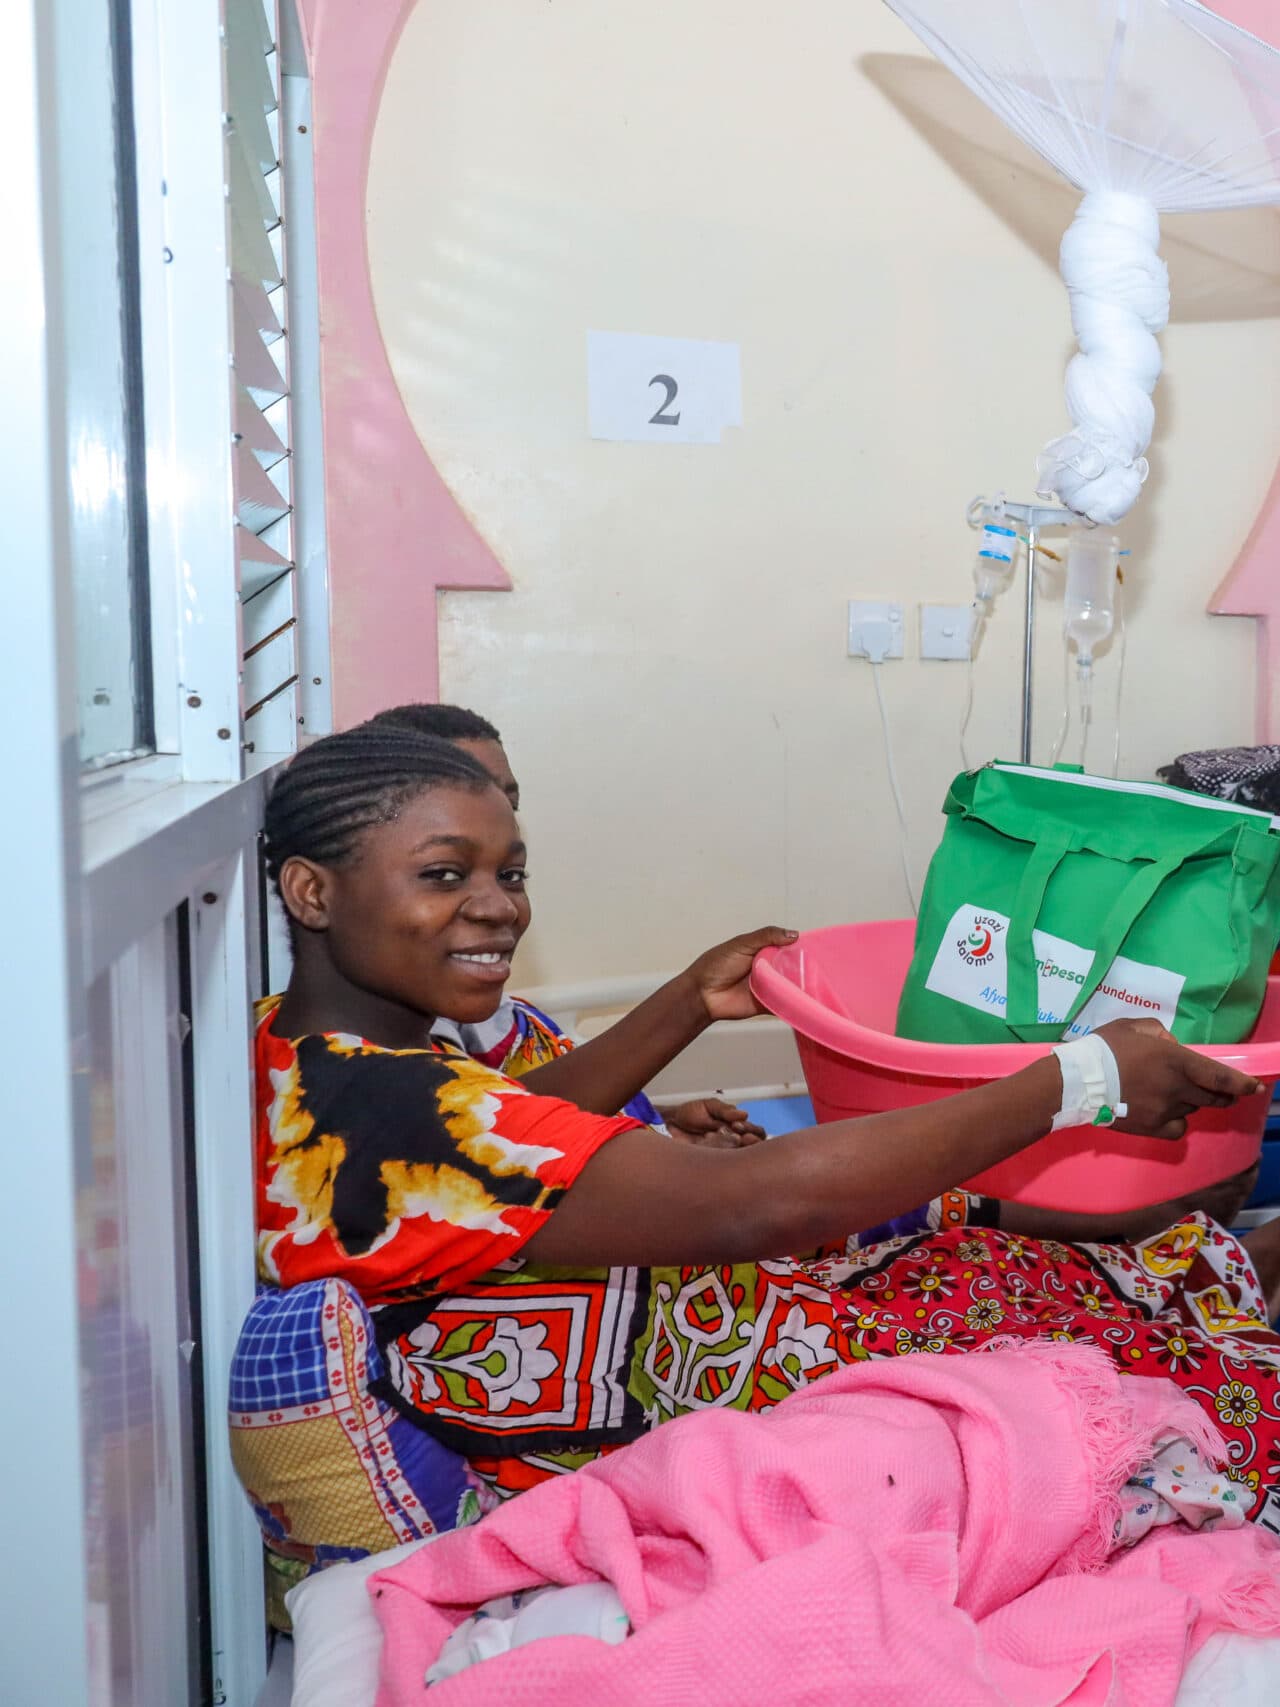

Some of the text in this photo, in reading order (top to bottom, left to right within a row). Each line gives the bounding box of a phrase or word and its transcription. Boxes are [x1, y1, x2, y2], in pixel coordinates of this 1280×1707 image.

[648, 374, 681, 426] 2
[957, 940, 994, 967] Salama
[980, 986, 1007, 1005] Afya
[1095, 983, 1161, 1011] oundation
